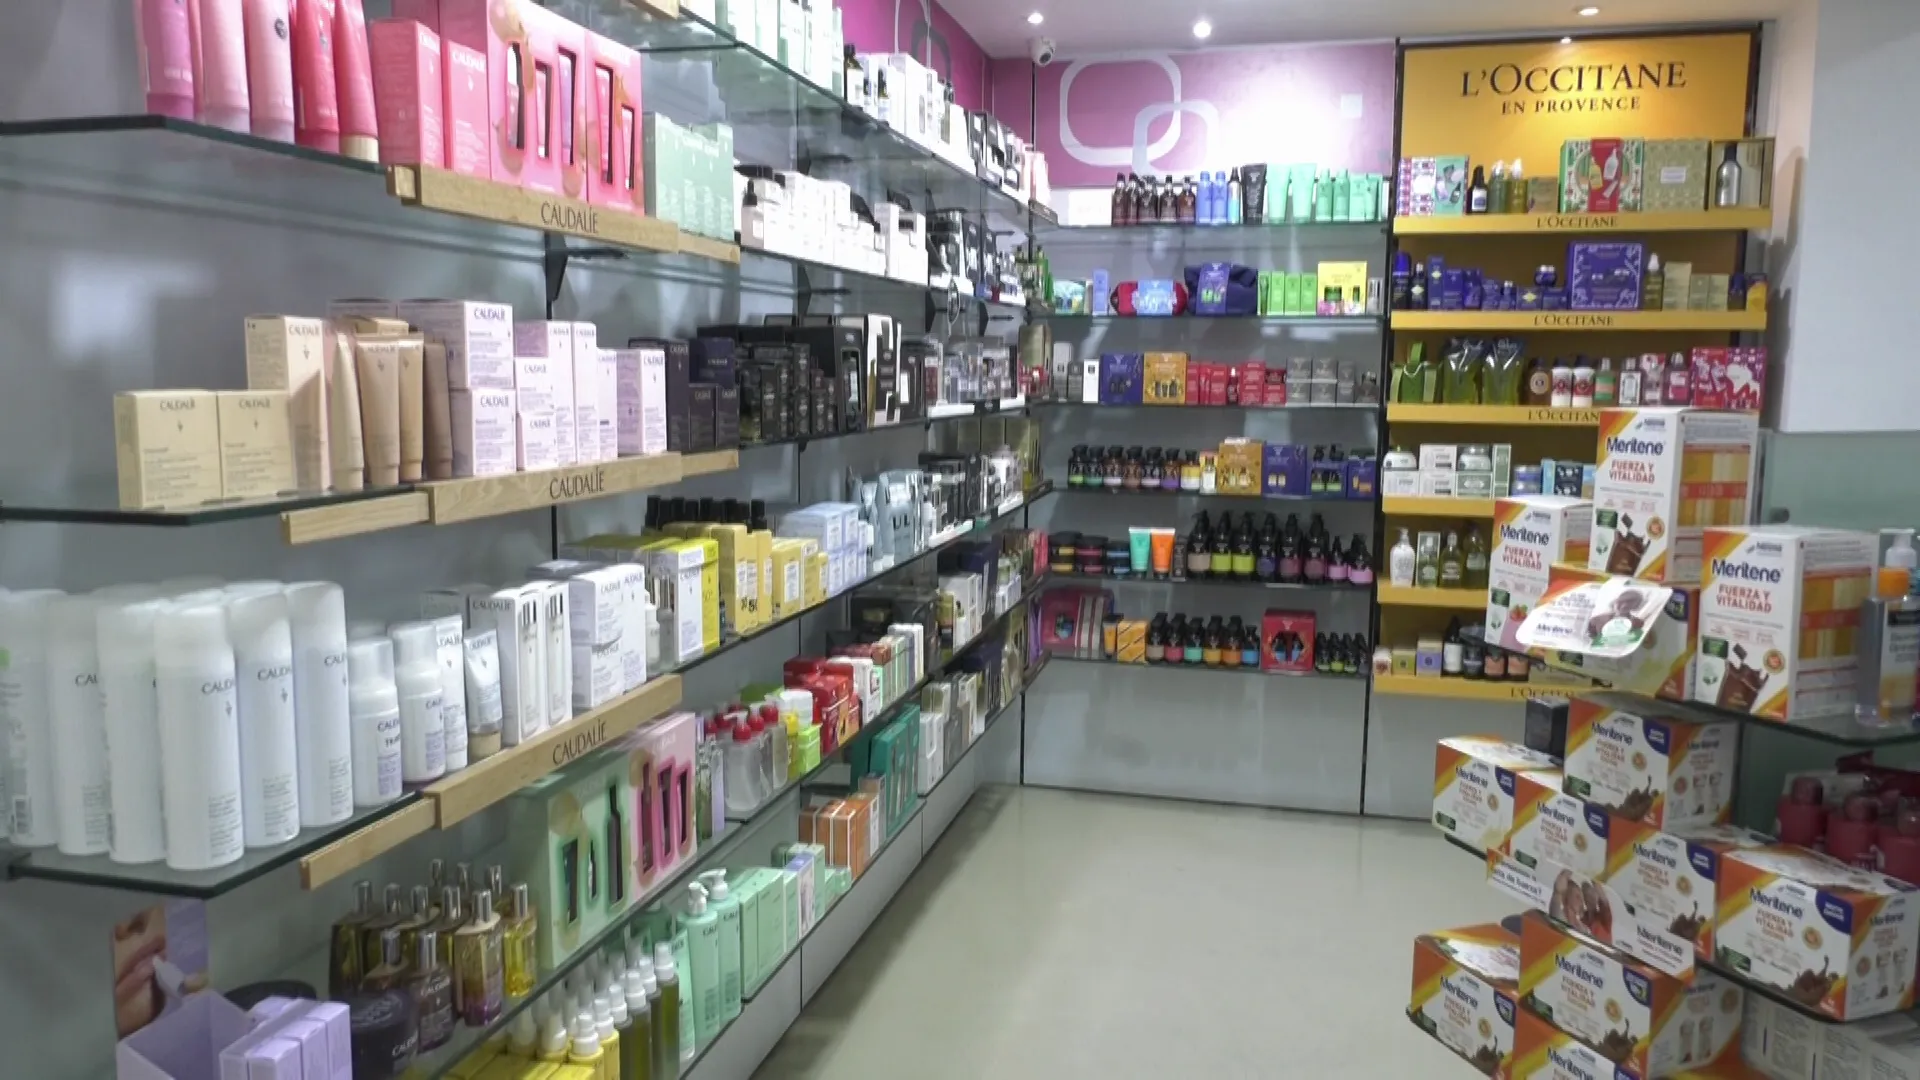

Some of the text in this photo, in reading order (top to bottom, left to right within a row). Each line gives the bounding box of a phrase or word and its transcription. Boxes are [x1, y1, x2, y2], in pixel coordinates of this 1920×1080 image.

[1461, 61, 1687, 97] L'OCCITANE
[1502, 96, 1641, 115] EN PROVENCE
[1528, 410, 1599, 421] L'OCCITAN
[1607, 436, 1663, 456] Meritene
[1612, 459, 1645, 472] FUERZA
[1609, 470, 1655, 484] VITALIDAD
[1500, 524, 1550, 546] Meritene
[1712, 559, 1782, 583] Meritene
[1719, 583, 1760, 600] FUERZA
[1716, 595, 1772, 613] VITALIDAD
[1750, 887, 1802, 919] Meritene
